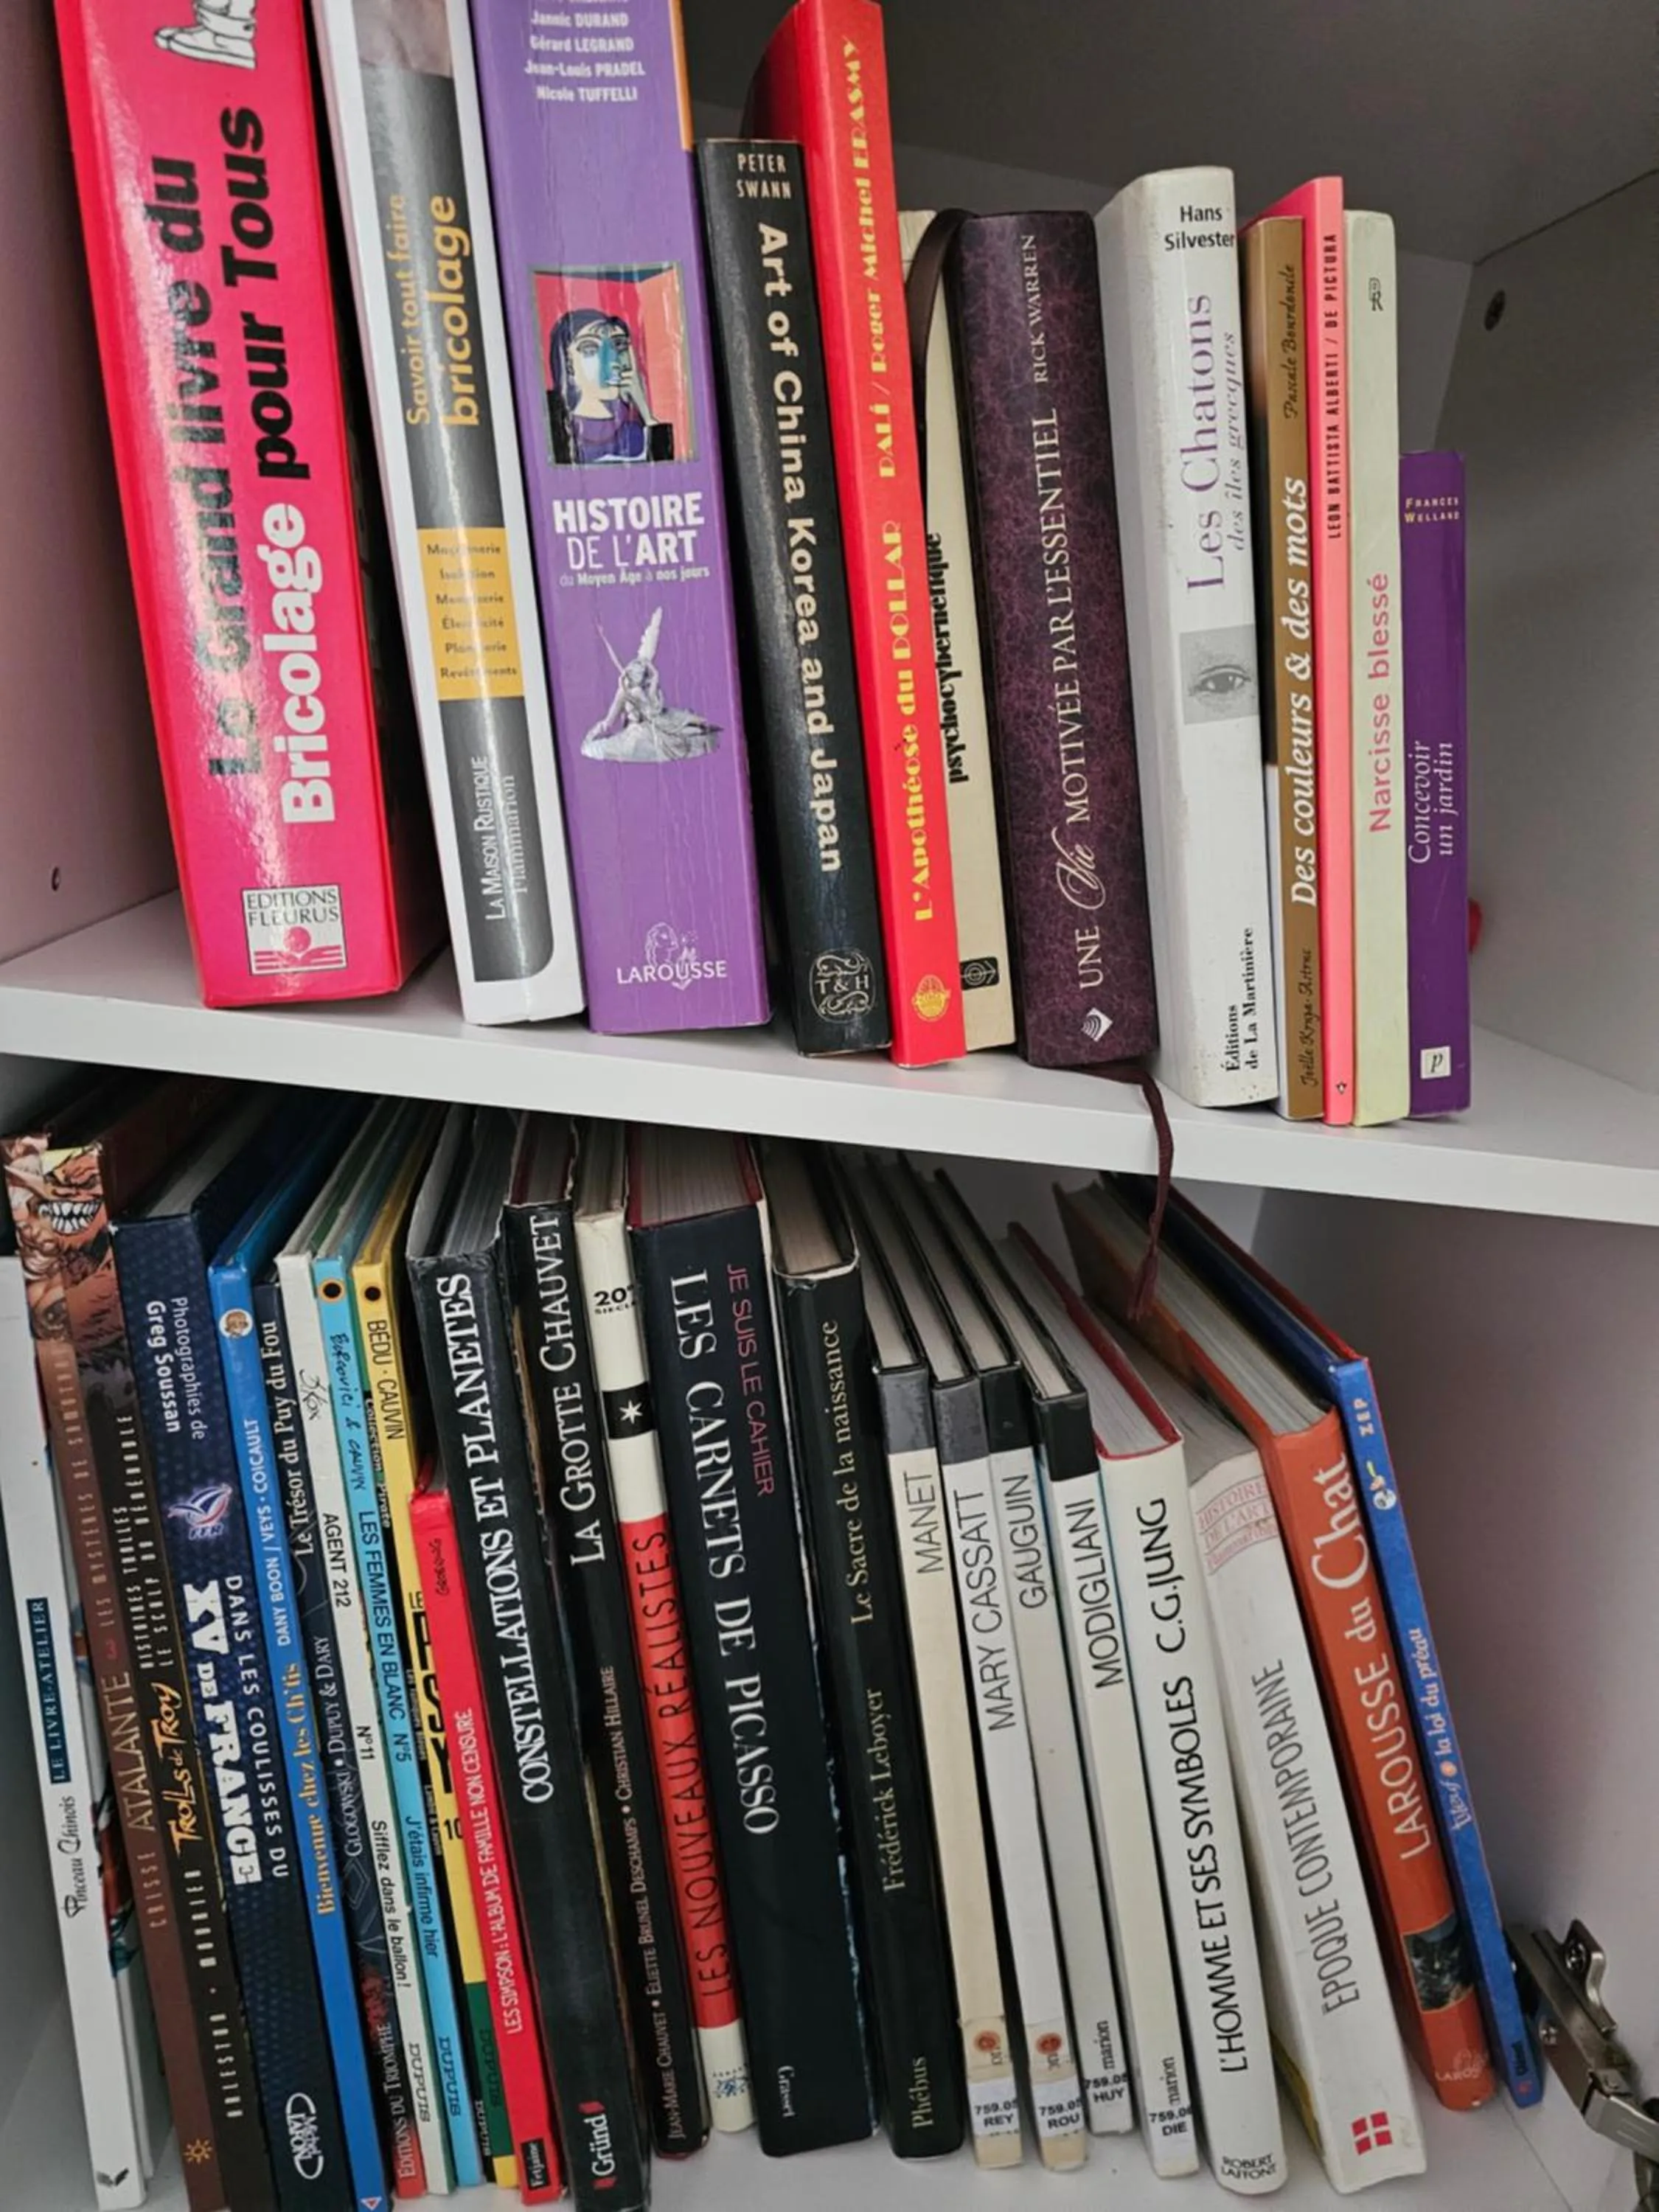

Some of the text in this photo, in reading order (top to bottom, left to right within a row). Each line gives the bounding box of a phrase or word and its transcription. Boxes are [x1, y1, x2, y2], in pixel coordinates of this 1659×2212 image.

[737, 153, 787, 173] PETER
[737, 180, 792, 201] SWANN
[1180, 206, 1223, 222] Hans
[1165, 231, 1235, 251] Silvester
[386, 193, 430, 425] Savoir tout faire
[426, 195, 479, 426] bricolage
[1181, 294, 1224, 591] Les Chatons
[1221, 333, 1243, 448] grecques
[1324, 234, 1342, 538] LEON BATTISTA ALBERTI DE PICTURA
[150, 156, 260, 777] Le Grand livre du
[221, 107, 335, 823] Bricolage pour Tous
[553, 492, 704, 536] HISTOIRE
[1228, 510, 1245, 552] des
[568, 529, 696, 569] DE L'ART
[758, 222, 841, 874] Art of China Korea and Japan
[883, 521, 911, 659] DOLLAR
[1021, 235, 1105, 989] UNE Vie MOTIVÉE PAR L'ESSENTIEL RICK WARREN
[897, 669, 916, 715] du
[1281, 477, 1317, 906] Des couleurs & des mots
[1367, 572, 1391, 832] Narcisse blessé
[902, 724, 933, 921] L'Apothéose
[1408, 741, 1432, 863] Concevoir
[1434, 742, 1458, 856] un jardin
[246, 888, 338, 908] EDITIONS
[248, 906, 339, 926] FLEURUS
[616, 960, 728, 985] LAROUSSE
[1222, 1004, 1240, 1071] Éditions
[1240, 928, 1259, 1068] de La Martinière
[147, 1300, 181, 1433] Greg Soussan
[171, 1297, 205, 1440] Photographies de
[378, 1378, 405, 1440] CAUVIN
[529, 1217, 606, 1566] LA GROTTE CHAUVET
[727, 1264, 774, 1497] JE SUIS LE CAHIER
[1354, 1399, 1374, 1436] ZEP
[260, 1321, 315, 1556] Le Trésor du Puy du Fou
[823, 1320, 873, 1624] Le Sacre de la naissance
[244, 1419, 291, 1646] DANY BOON VEYS COICAULT
[323, 1513, 352, 1608] AGENT 212
[437, 1273, 553, 1804] CONSTELLATIONS ET PLANETES
[671, 1269, 779, 1835] LES CARNETS DE PICASSO
[904, 1471, 944, 1573] MANET
[1002, 1475, 1048, 1608] GAUGUIN
[183, 1579, 229, 1656] XV
[358, 1511, 406, 1720] LES FEMMES EN BLANC
[953, 1489, 1016, 1731] MARY CASSATT
[1065, 1499, 1124, 1688] MODIGLIANI
[1311, 1453, 1431, 1860] LAROUSSE du Chat
[101, 1671, 156, 1831] ATALANTE
[225, 1575, 288, 1878] DANS LES COULISSES DU
[293, 1728, 312, 1757] les
[1163, 1676, 1214, 1837] SYMBOLES
[1409, 1627, 1453, 1758] la loi du préau
[204, 1700, 262, 1885] FRANCE
[299, 1761, 319, 1808] chez
[633, 1531, 733, 1997] LES NOUVEAUX RÉALISTES
[866, 1688, 905, 1892] Frédérick Leboyer
[308, 1815, 335, 1915] Bienvenue
[372, 1819, 407, 1980] Sifflez dans le ballon
[406, 1816, 438, 1958] J'étais infirme hier
[1188, 1843, 1220, 1894] SES
[1251, 1659, 1360, 2015] EPOQUE CONTEMPORAINE
[1194, 1901, 1226, 1930] ET
[1202, 1937, 1248, 2073] L'HOMME
[409, 2042, 430, 2122] DUPUIS
[439, 2037, 461, 2117] DUPUIS
[908, 2056, 933, 2129] Phébus
[984, 2113, 1014, 2127] REY
[1048, 2115, 1081, 2129] ROU
[1093, 2088, 1125, 2104] HUY
[1161, 2122, 1187, 2136] DIE
[584, 2115, 615, 2177] Gründ
